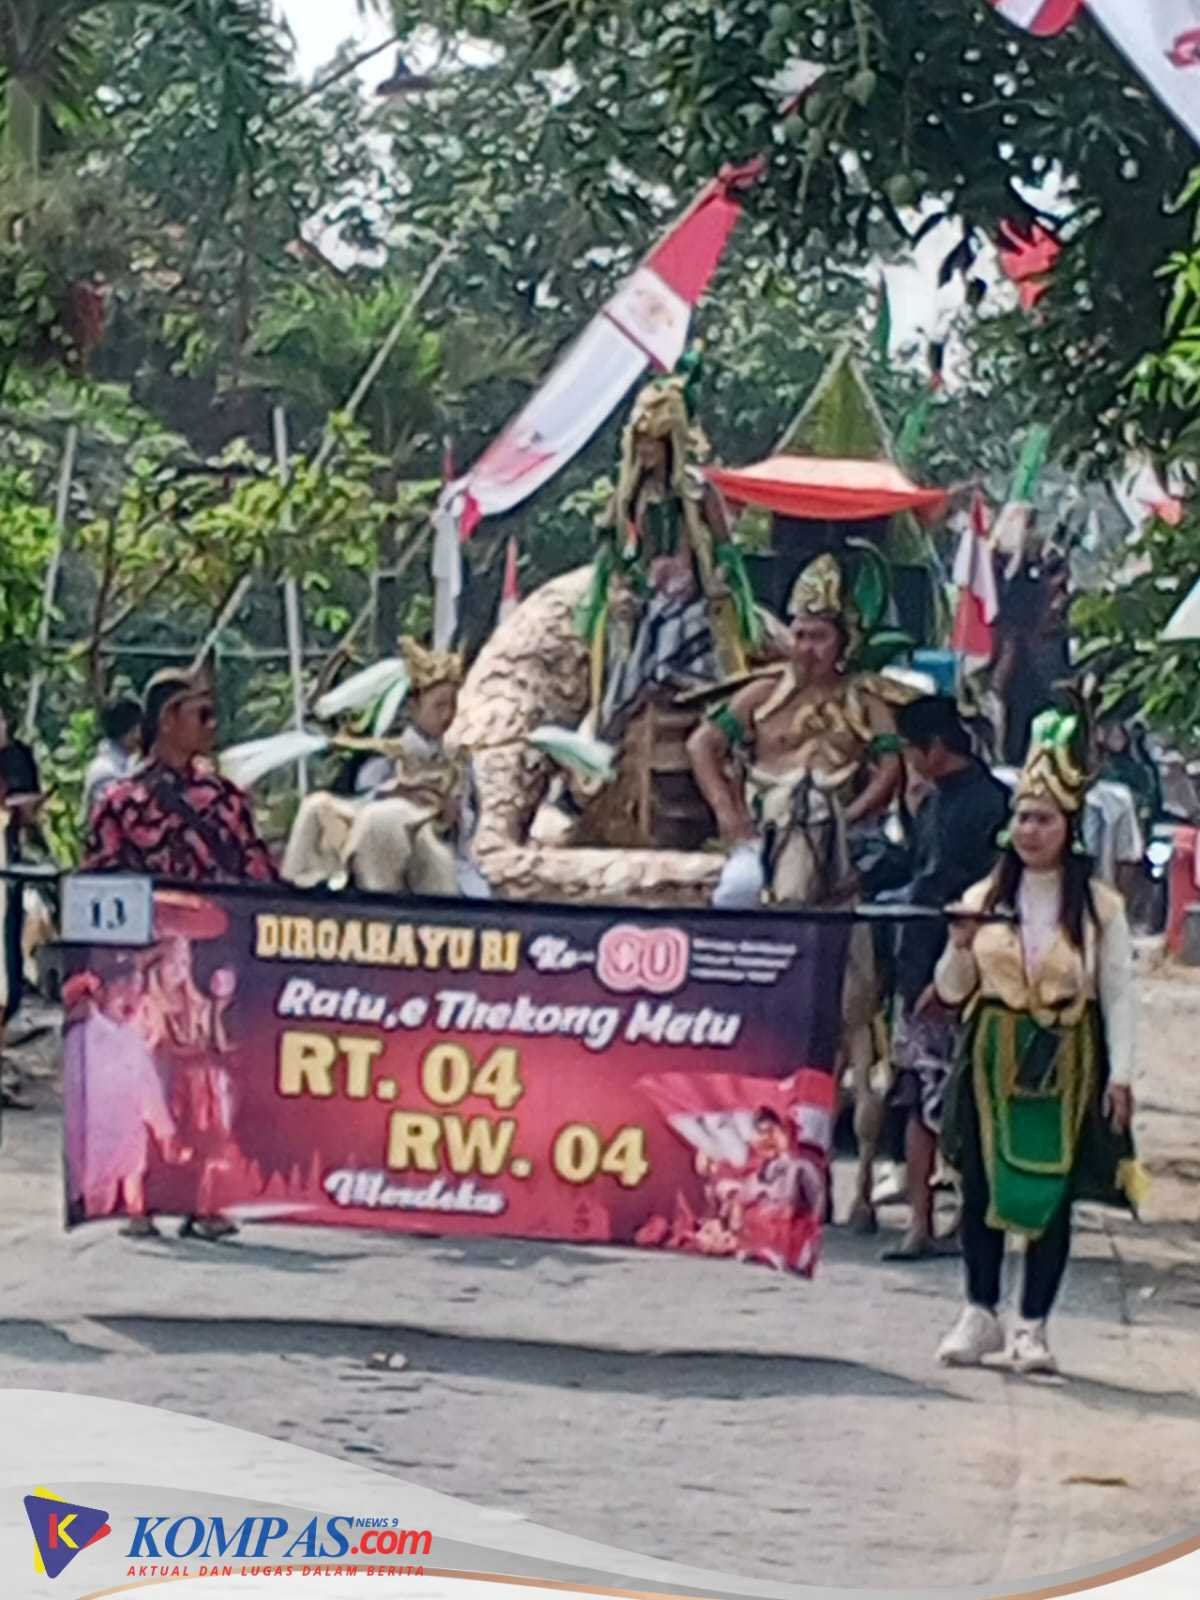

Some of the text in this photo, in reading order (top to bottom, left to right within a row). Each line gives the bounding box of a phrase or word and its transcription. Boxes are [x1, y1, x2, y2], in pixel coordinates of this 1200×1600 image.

[279, 1031, 524, 1108] RT. 04
[387, 1111, 649, 1186] RW. 04
